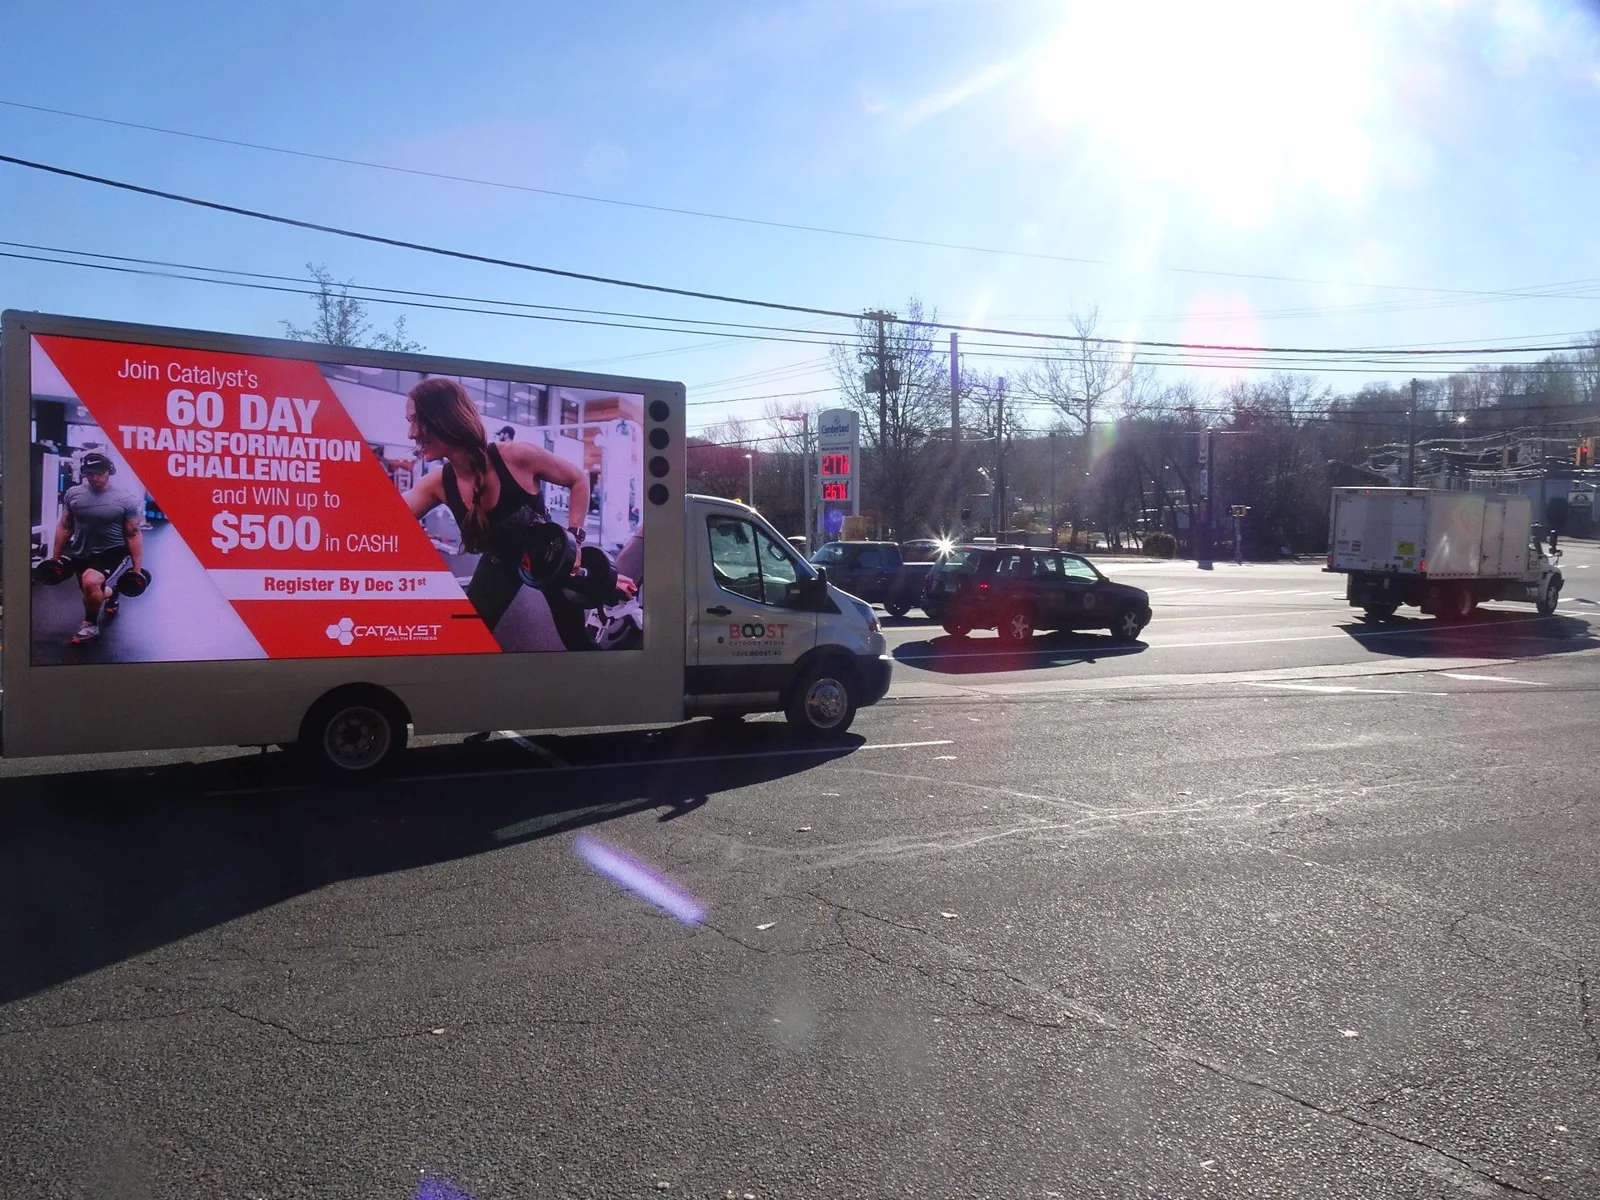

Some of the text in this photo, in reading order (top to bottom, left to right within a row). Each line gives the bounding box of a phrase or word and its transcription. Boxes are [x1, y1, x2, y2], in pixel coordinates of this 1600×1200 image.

[118, 359, 258, 390] Join Catalyst's
[166, 388, 321, 434] 60 DAY
[118, 425, 361, 462] TRANSFORMATION
[167, 453, 321, 484] CHALLENGE
[212, 486, 340, 511] and WIN up to
[211, 510, 399, 554] $500 in CASH!
[264, 577, 427, 594] Register By Dec 31st
[354, 625, 442, 640] CATALYST
[729, 623, 788, 639] BOOST
